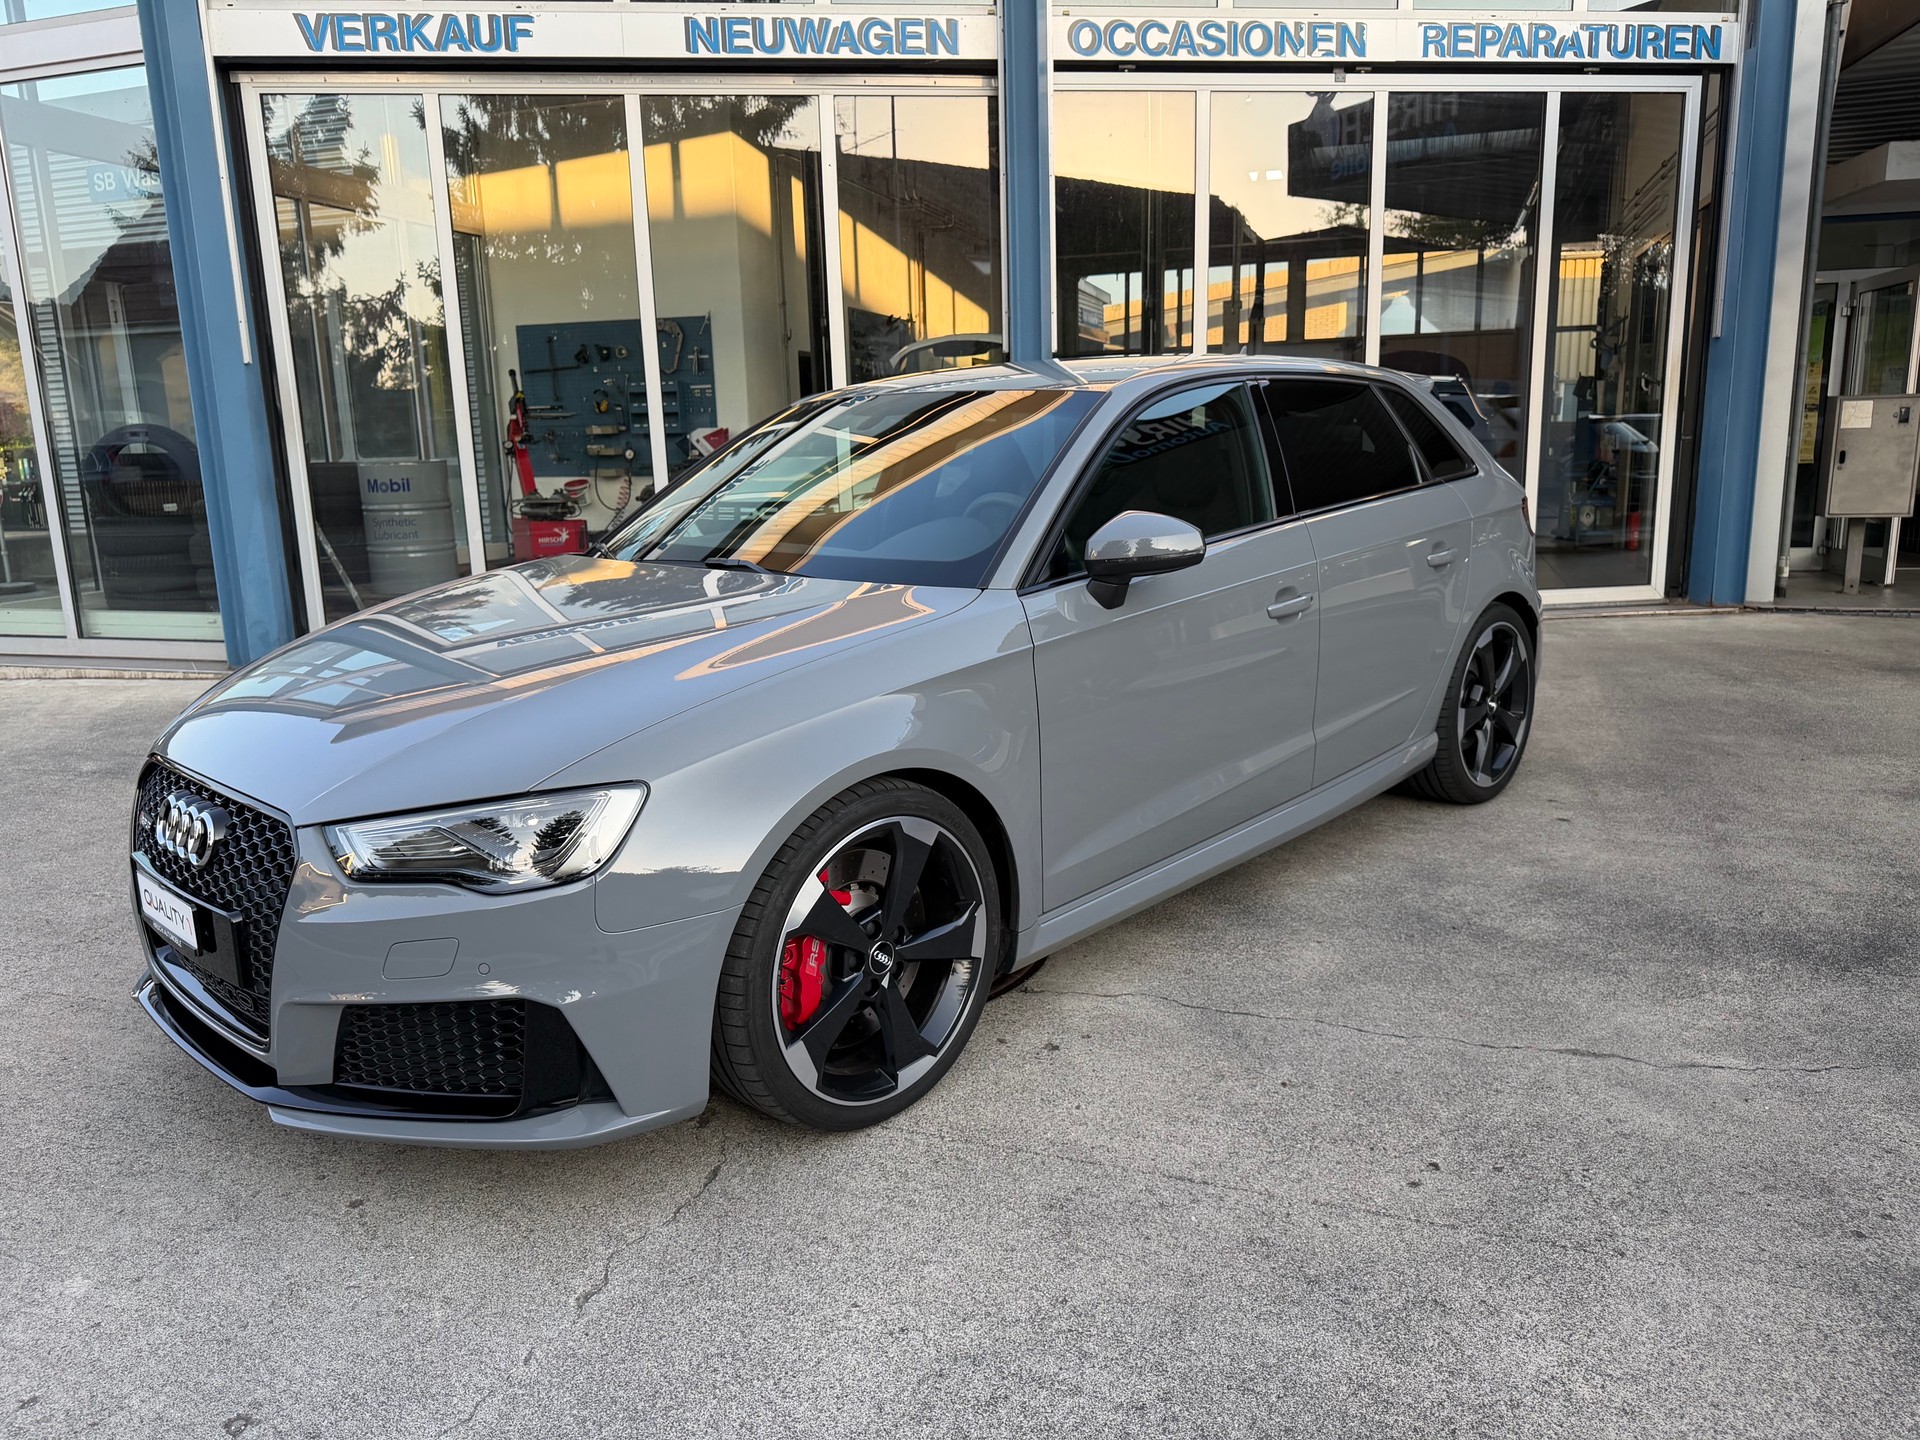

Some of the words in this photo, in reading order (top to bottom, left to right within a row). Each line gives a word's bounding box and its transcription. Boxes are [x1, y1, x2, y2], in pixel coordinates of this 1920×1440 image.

[292, 12, 535, 53] VERKAUF
[684, 16, 960, 55] NEUWAGEN
[1067, 18, 1367, 58] OCCASIONEN
[1417, 22, 1723, 60] REPARATUREN
[93, 172, 116, 192] SB
[367, 478, 411, 494] Mobil
[372, 517, 417, 529] Synthetic
[374, 530, 419, 541] Lubricant
